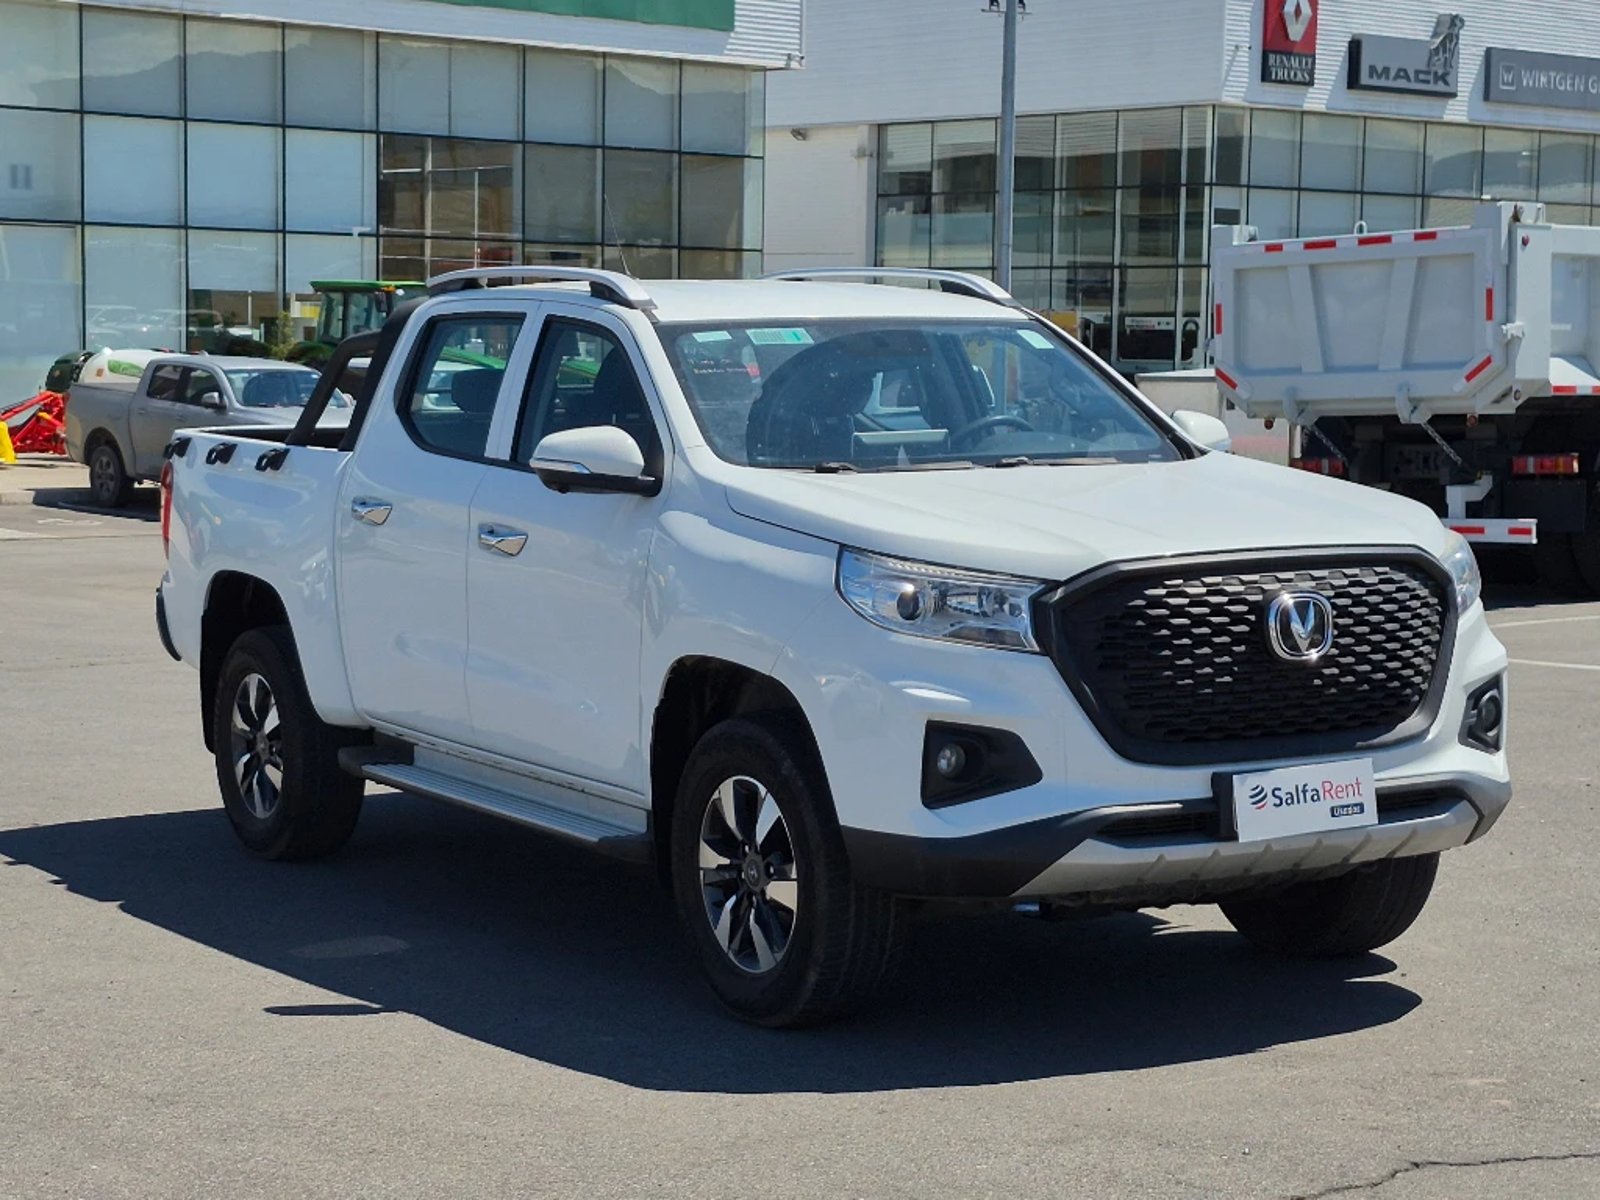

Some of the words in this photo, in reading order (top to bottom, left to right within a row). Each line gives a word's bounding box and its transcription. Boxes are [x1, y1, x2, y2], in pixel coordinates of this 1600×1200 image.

[1268, 53, 1312, 69] RENAULT
[1270, 67, 1310, 83] TRUCKS
[1368, 64, 1451, 87] MACK
[1520, 69, 1585, 92] WIRTGEN
[1271, 777, 1363, 808] SalfaRent
